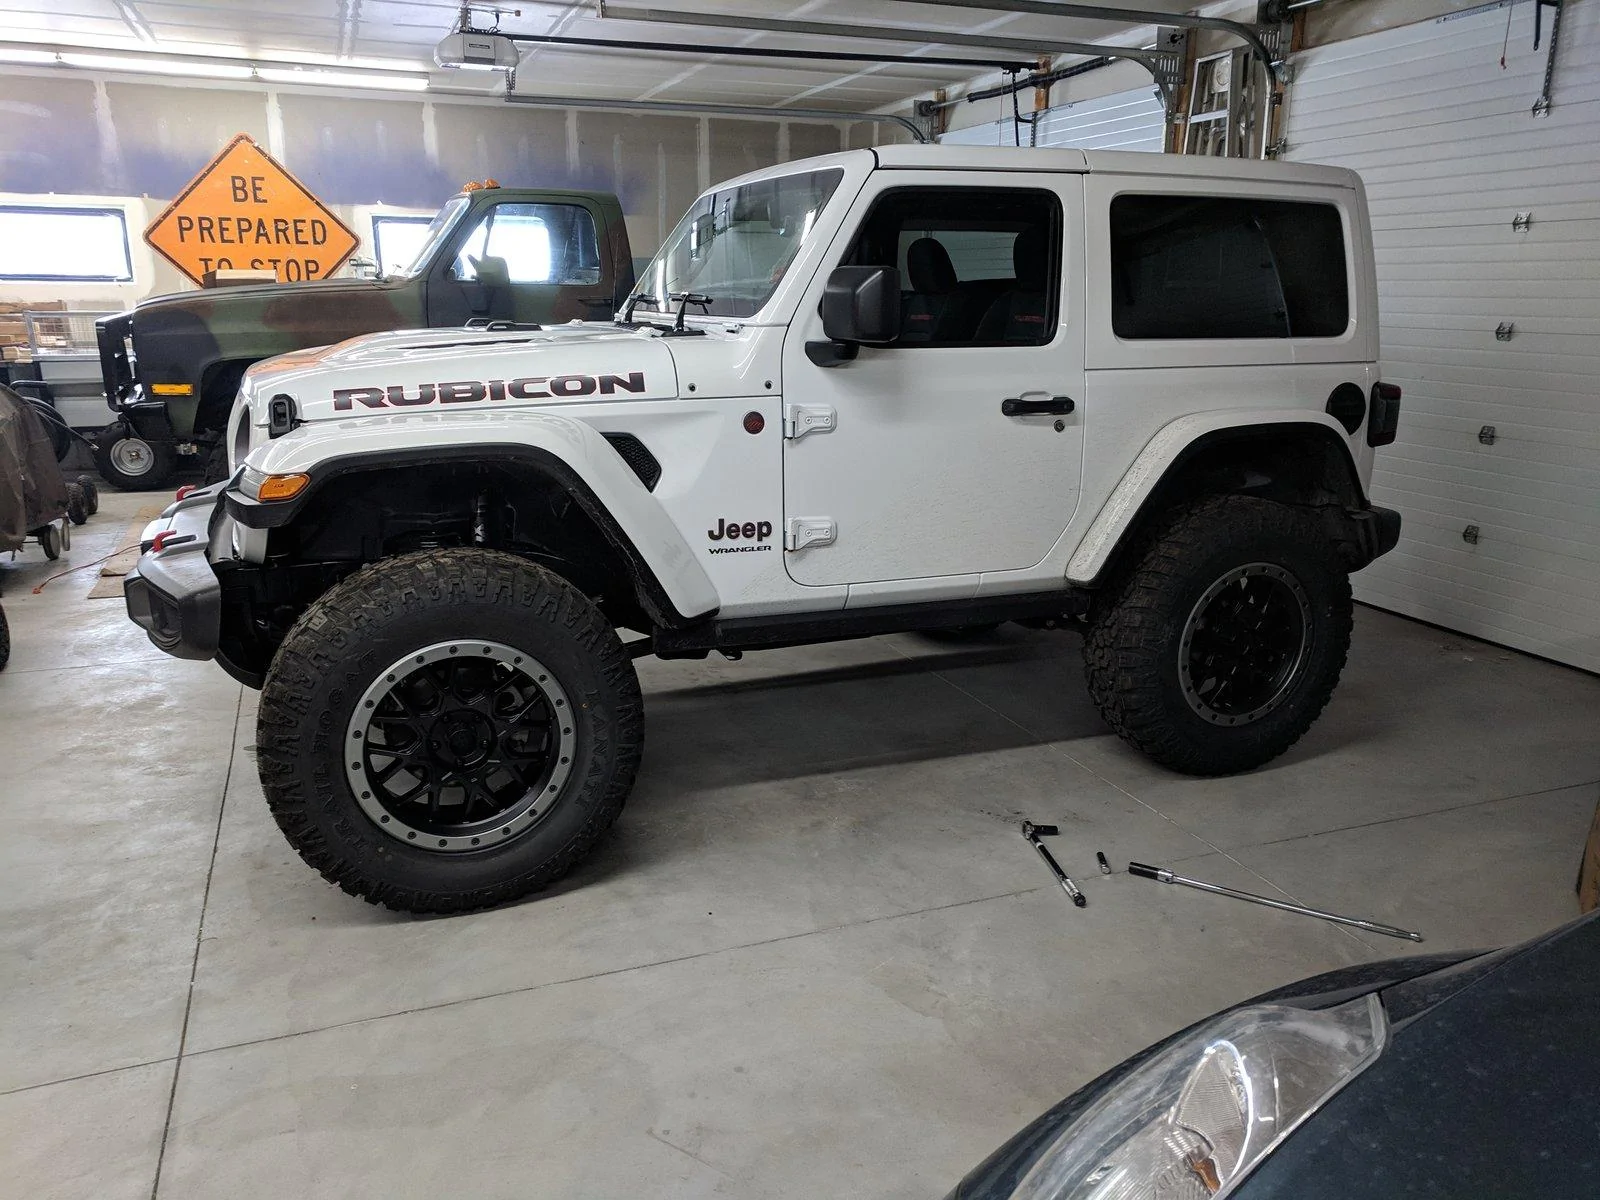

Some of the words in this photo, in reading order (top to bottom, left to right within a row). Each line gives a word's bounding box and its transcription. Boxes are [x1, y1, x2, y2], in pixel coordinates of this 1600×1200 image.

[230, 175, 268, 203] BE
[177, 216, 327, 245] PREPARED
[333, 372, 646, 411] RUBICON
[708, 518, 772, 542] Jeep
[708, 545, 772, 555] WRANGLER
